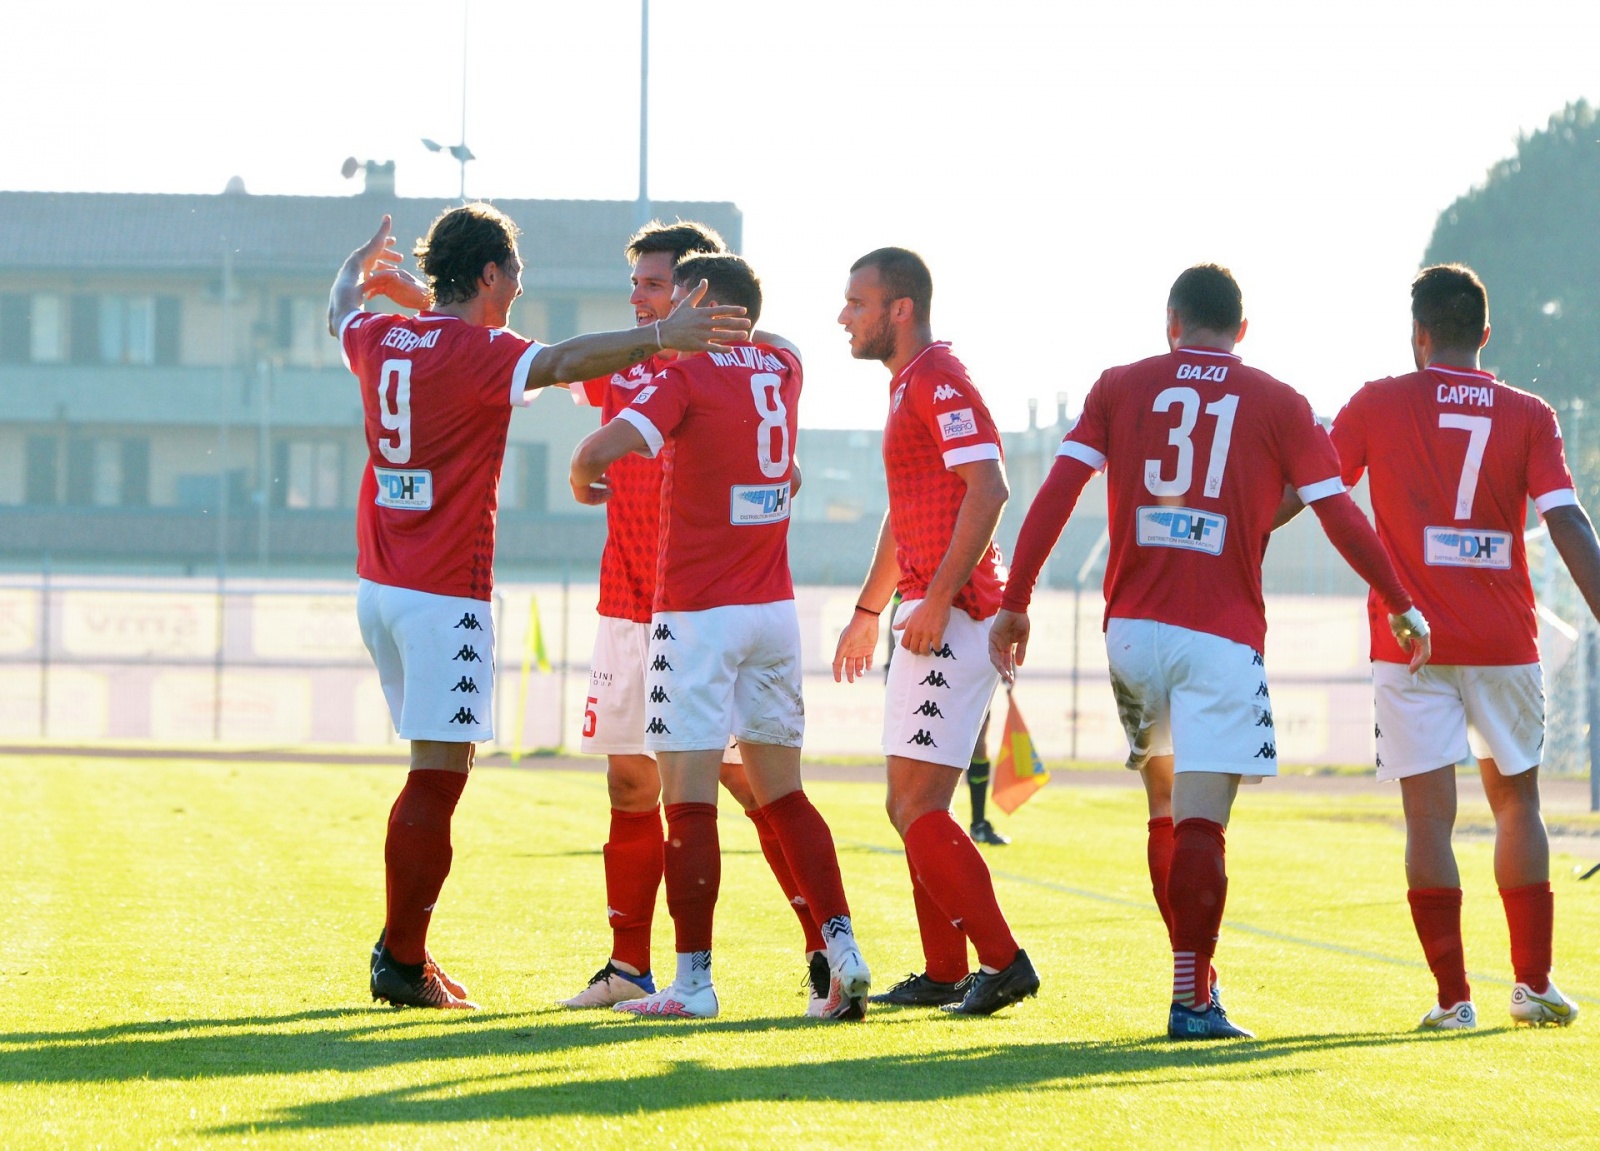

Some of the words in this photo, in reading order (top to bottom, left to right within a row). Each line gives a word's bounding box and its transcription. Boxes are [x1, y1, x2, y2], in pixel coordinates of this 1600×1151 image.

[1176, 364, 1229, 382] GAZO
[1437, 384, 1494, 407] CAPPAI
[378, 359, 412, 464] 9
[751, 373, 790, 478] 8
[943, 422, 973, 435] FABBRO
[1144, 386, 1240, 498] 31
[1438, 413, 1492, 520] 7
[388, 474, 426, 500] DHF
[1170, 512, 1219, 541] DHF
[1459, 535, 1505, 559] DHF
[590, 670, 613, 681] LINI
[590, 679, 612, 687] OUP
[582, 696, 598, 737] 5
